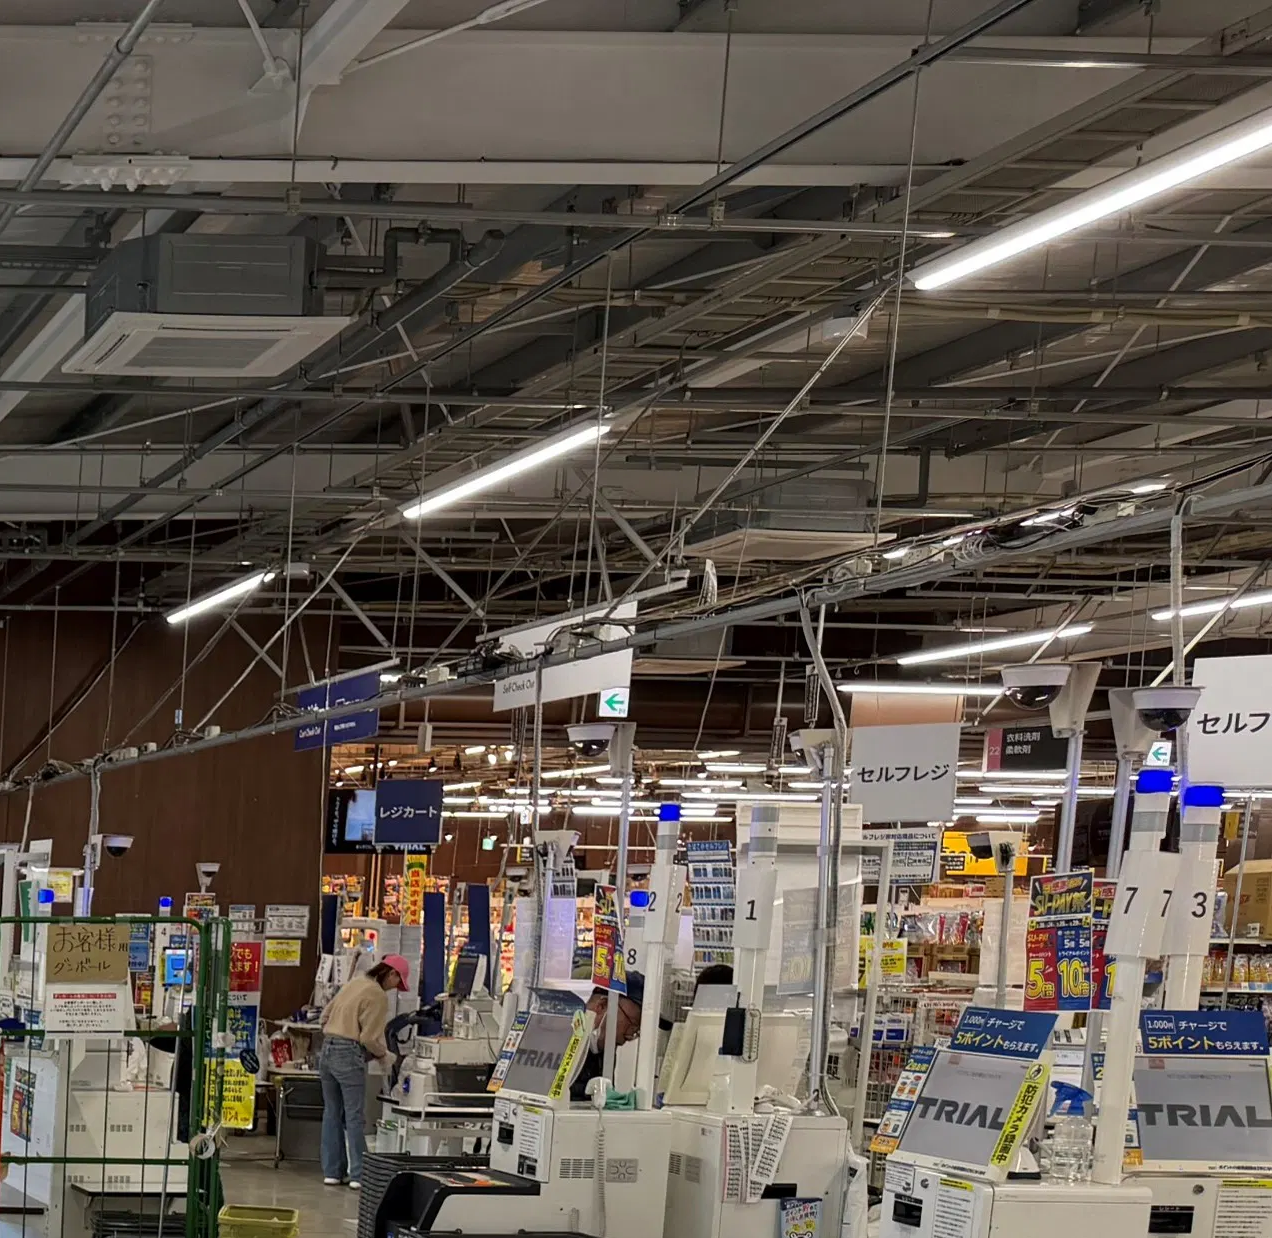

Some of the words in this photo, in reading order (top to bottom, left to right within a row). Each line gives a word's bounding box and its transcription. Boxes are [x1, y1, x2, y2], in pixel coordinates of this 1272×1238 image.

[989, 746, 1000, 756] 22
[857, 763, 951, 784] セルフレジ
[379, 806, 438, 819] レジカート
[648, 891, 657, 912] 2
[675, 892, 683, 914] 2
[745, 899, 758, 921] 1
[1124, 886, 1137, 915] 7
[1161, 889, 1173, 918] 7
[1191, 891, 1208, 919] 3
[627, 948, 637, 965] 8
[986, 1017, 1026, 1031] チャージで
[1178, 1021, 1228, 1032] チャージで
[954, 1031, 1040, 1054] 5ポイントもらえます。
[1148, 1035, 1264, 1051] 5ポイントもらえます。
[917, 1096, 1006, 1131] TRIAL
[995, 1083, 1039, 1165] 防犯カメラ録画中
[1136, 1103, 1272, 1129] TRIAL
